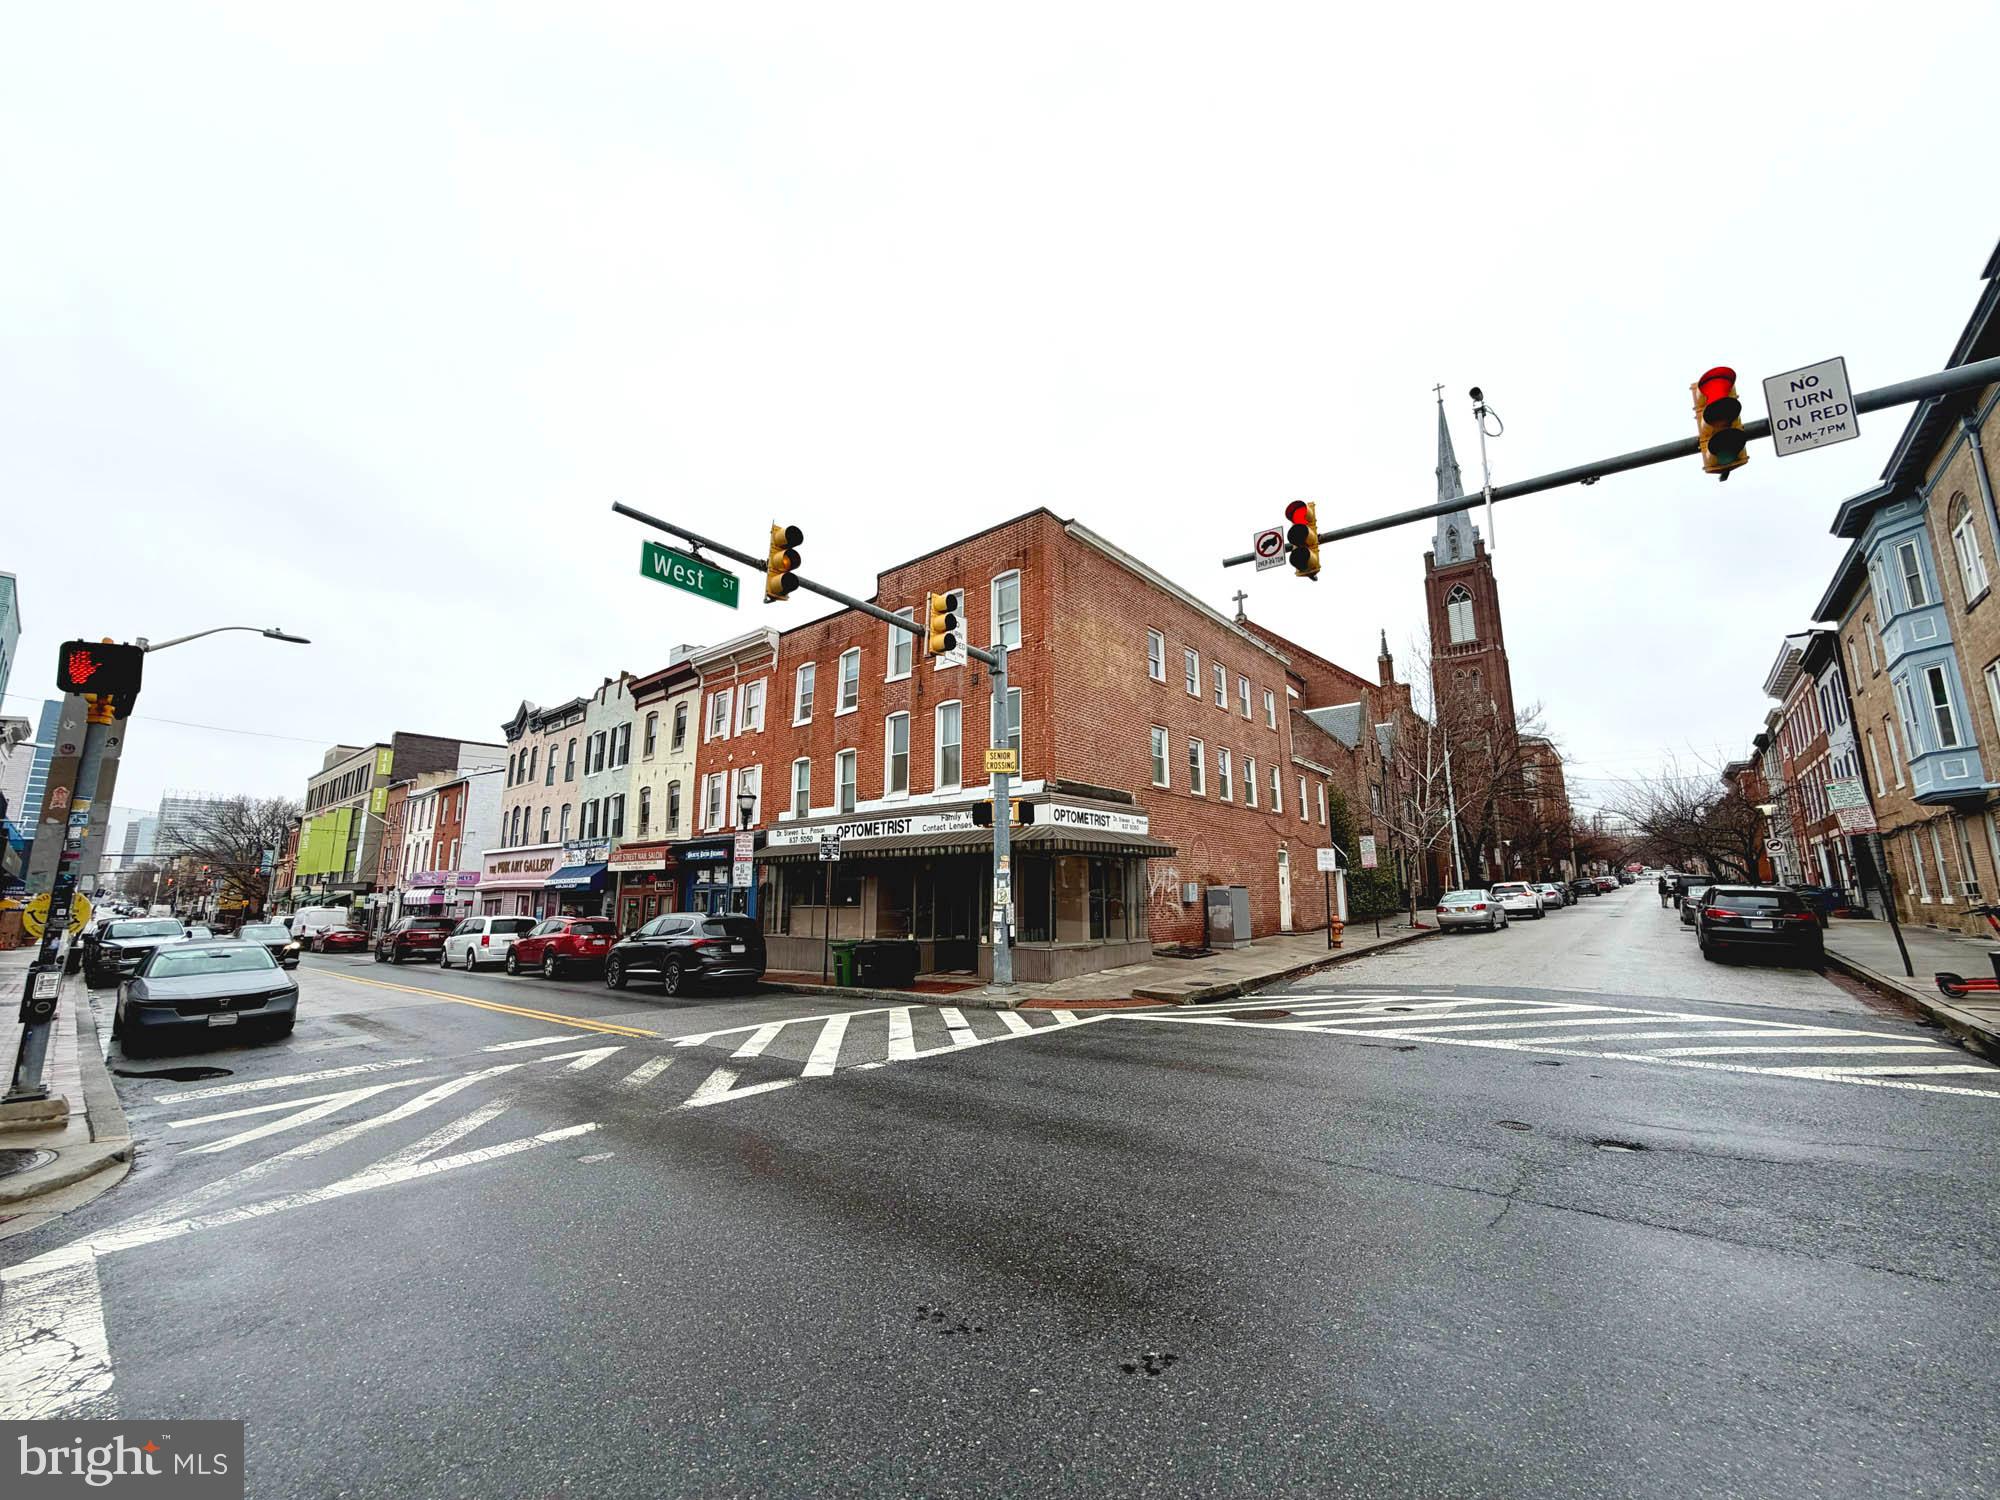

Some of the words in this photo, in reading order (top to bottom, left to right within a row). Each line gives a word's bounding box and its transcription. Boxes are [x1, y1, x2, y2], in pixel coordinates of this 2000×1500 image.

[1790, 375, 1819, 392] NO
[1784, 388, 1834, 411] TURN
[1776, 415, 1802, 431] ON
[1810, 403, 1848, 423] RED
[1784, 422, 1846, 445] 7AM-7PM
[653, 552, 704, 590] West
[722, 577, 735, 591] ST
[990, 751, 1011, 760] SENIOR
[986, 761, 1015, 770] CROSSING
[941, 811, 962, 821] Family
[1053, 808, 1111, 828] OPTOMETRIST
[836, 818, 912, 838] OPTOMETRIST
[922, 823, 947, 832] Contact
[948, 821, 973, 831] Lenses
[489, 865, 497, 874] THE
[497, 860, 511, 873] PINK
[511, 859, 523, 873] ART
[523, 857, 555, 873] GALLERY
[610, 854, 622, 863] LIGHT
[622, 853, 637, 862] STREET
[637, 852, 648, 861] NAIL
[648, 851, 663, 860] SALON
